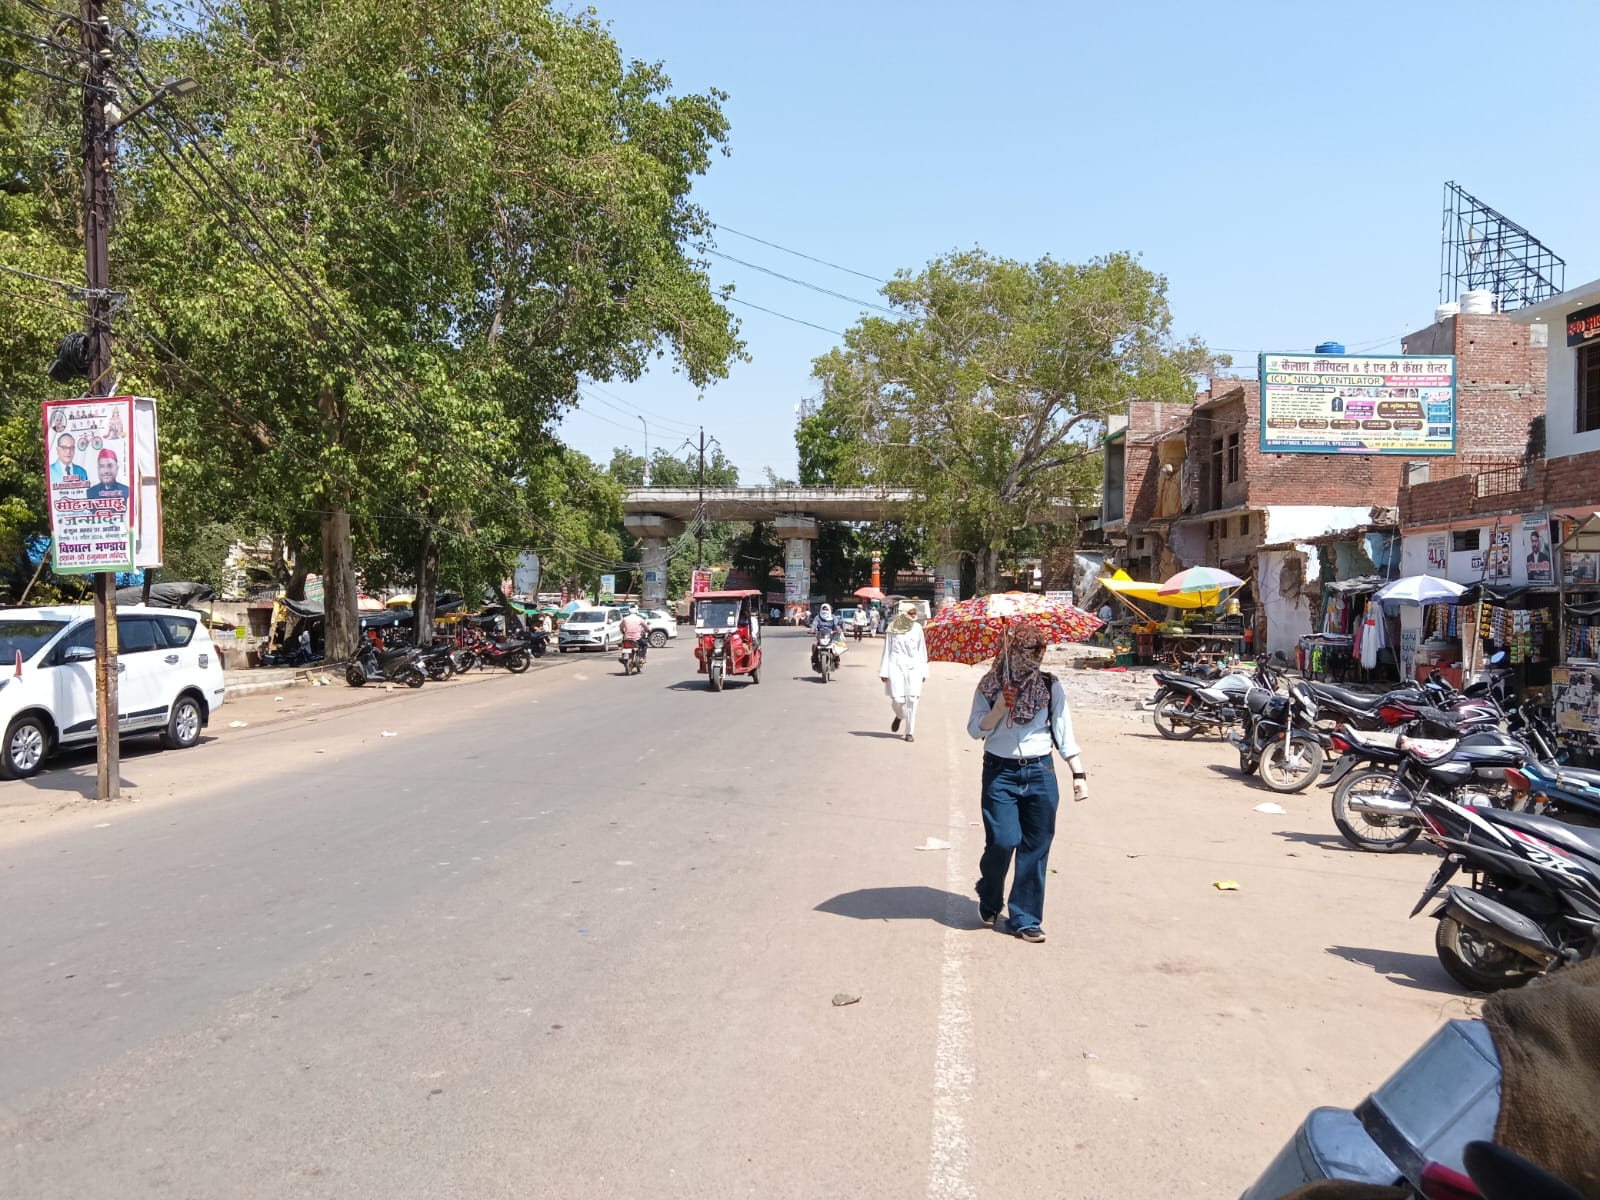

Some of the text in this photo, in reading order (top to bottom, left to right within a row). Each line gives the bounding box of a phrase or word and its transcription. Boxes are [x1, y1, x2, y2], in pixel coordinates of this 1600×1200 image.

[1281, 358, 1310, 372] कैलाश
[1313, 360, 1349, 373] हॉस्पिटल
[1353, 363, 1360, 373] &
[1427, 361, 1449, 374] सेन्टर
[1270, 375, 1287, 383] ICU
[1293, 375, 1317, 384] NICU
[1324, 376, 1380, 385] VENTILATOR
[56, 498, 126, 511] मोहन साहू
[64, 511, 125, 525] जन्मदिन
[1497, 532, 1511, 543] 25
[59, 542, 128, 553] विशाल भण्डारा
